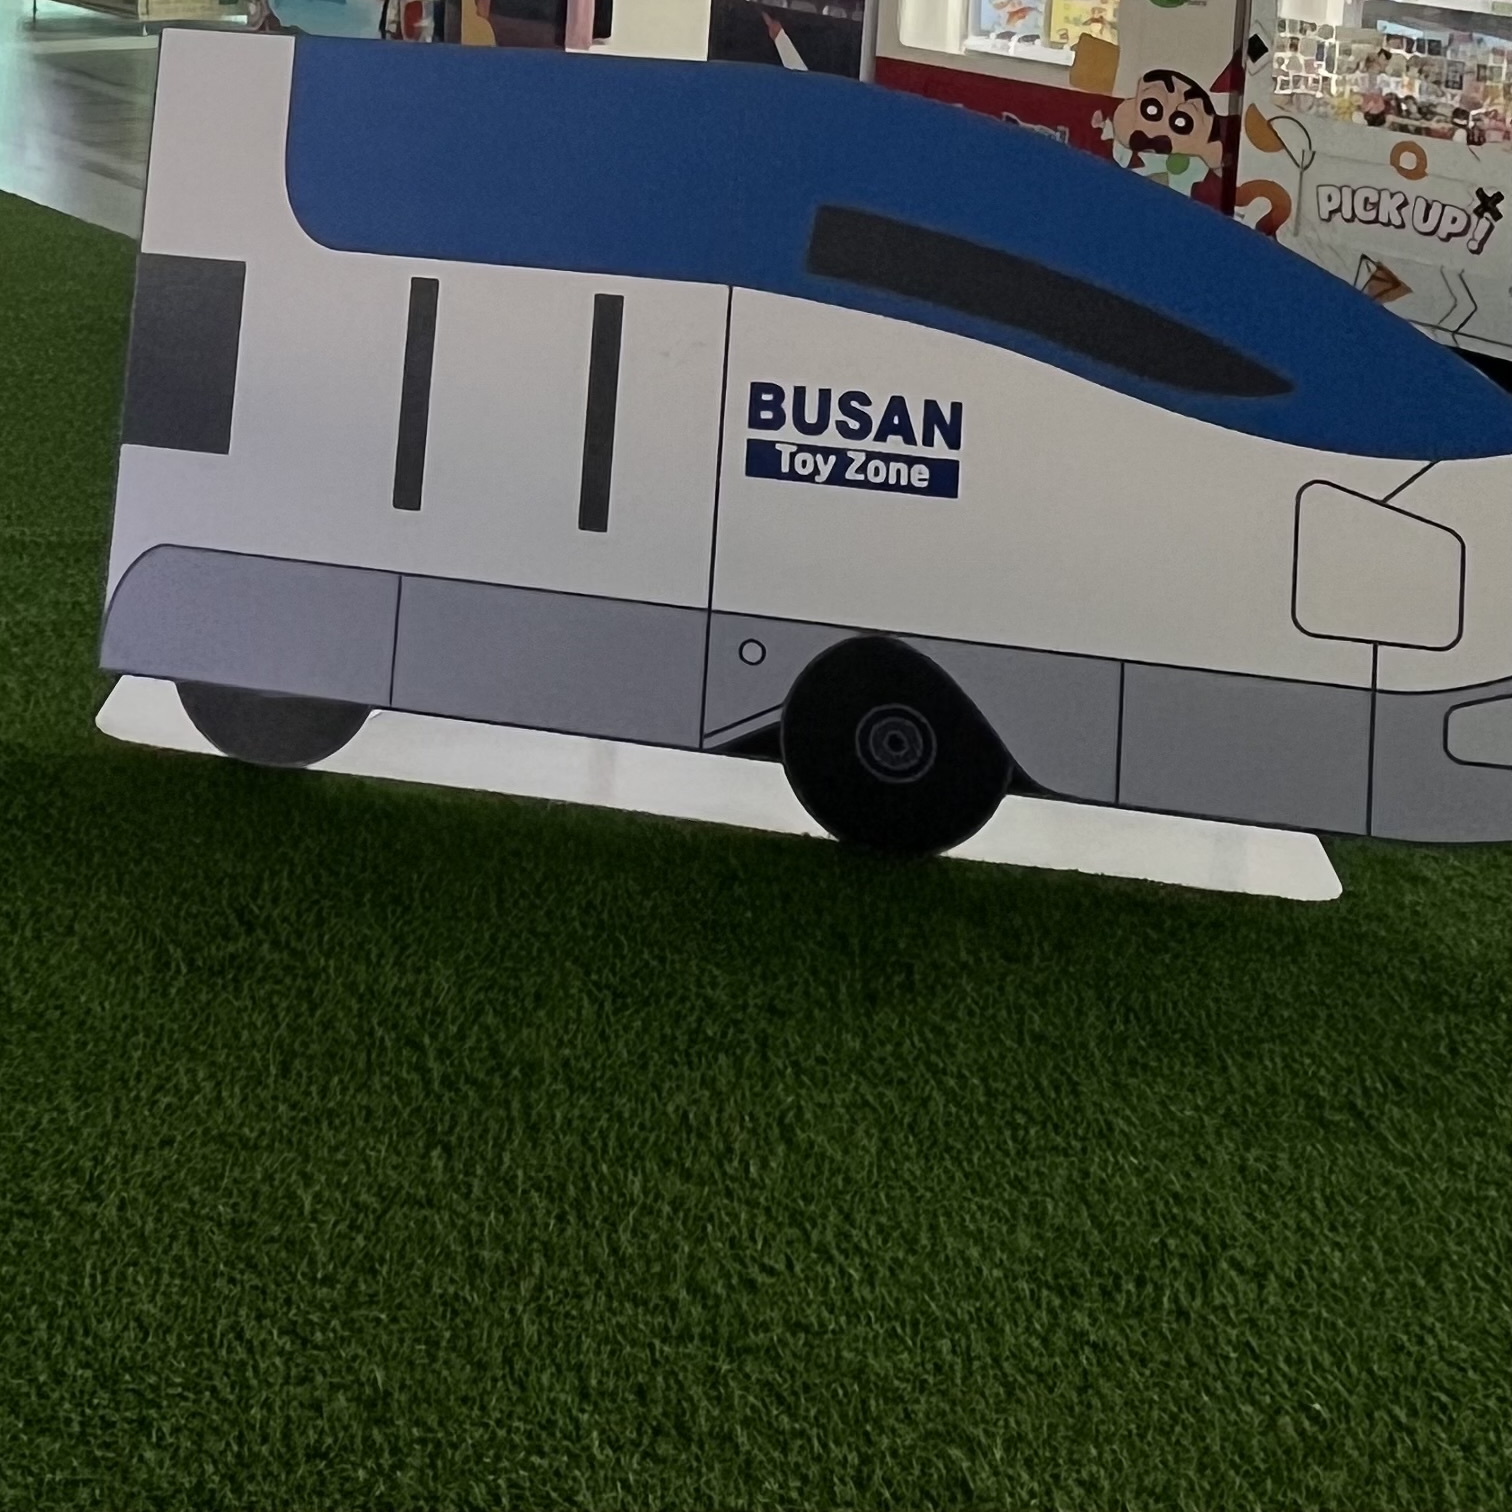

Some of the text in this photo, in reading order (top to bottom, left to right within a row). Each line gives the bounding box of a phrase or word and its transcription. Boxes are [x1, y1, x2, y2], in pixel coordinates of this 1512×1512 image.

[1316, 183, 1410, 230] PICK
[747, 381, 964, 451] BUSAN
[774, 442, 931, 488] Toy Zone
